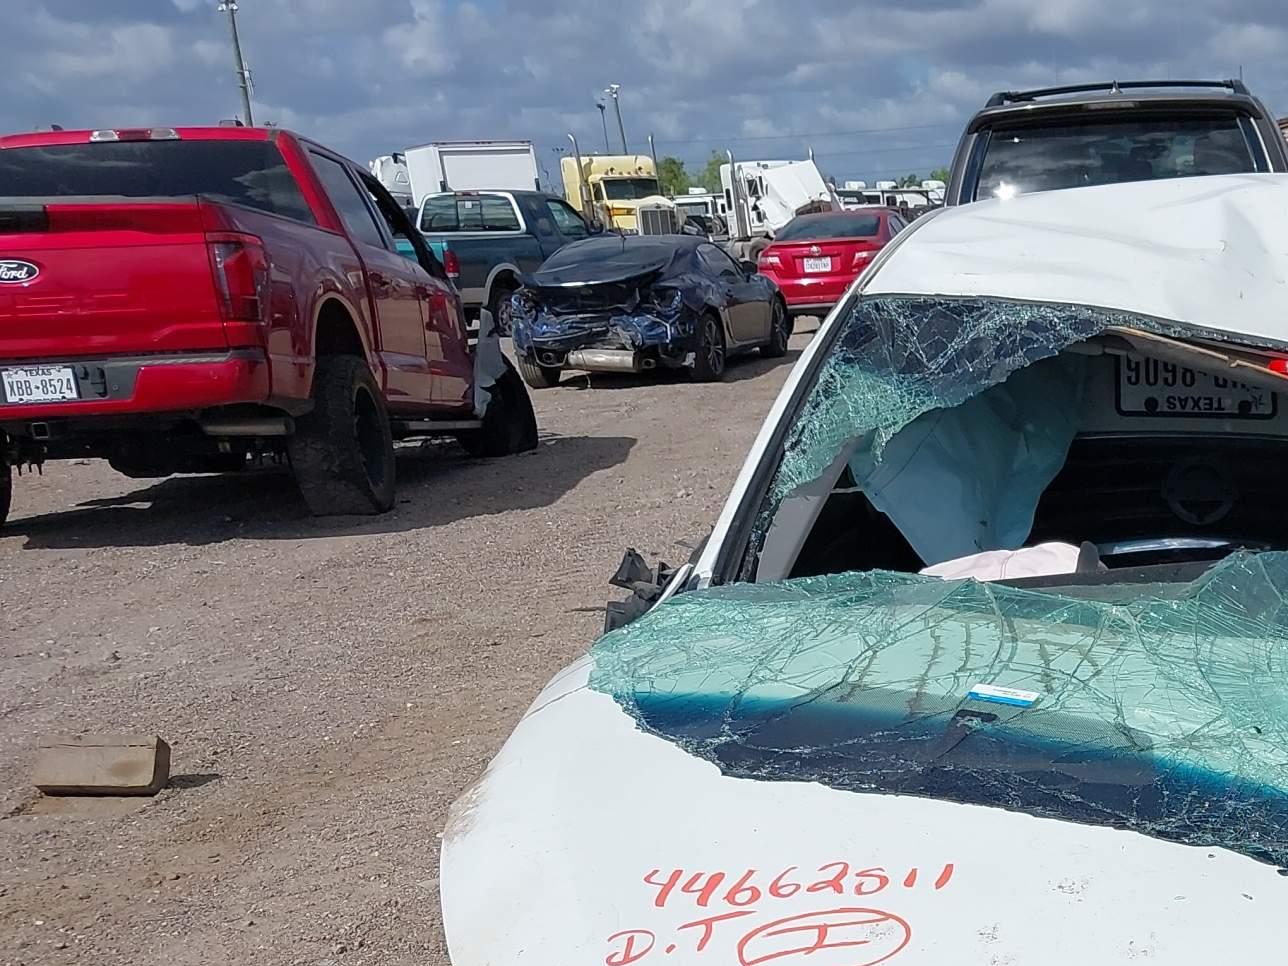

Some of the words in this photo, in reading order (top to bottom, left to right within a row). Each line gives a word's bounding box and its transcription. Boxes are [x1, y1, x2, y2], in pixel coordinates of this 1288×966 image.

[0, 263, 29, 279] Ford
[25, 368, 53, 376] TEXAS
[1166, 395, 1225, 411] TEXAS
